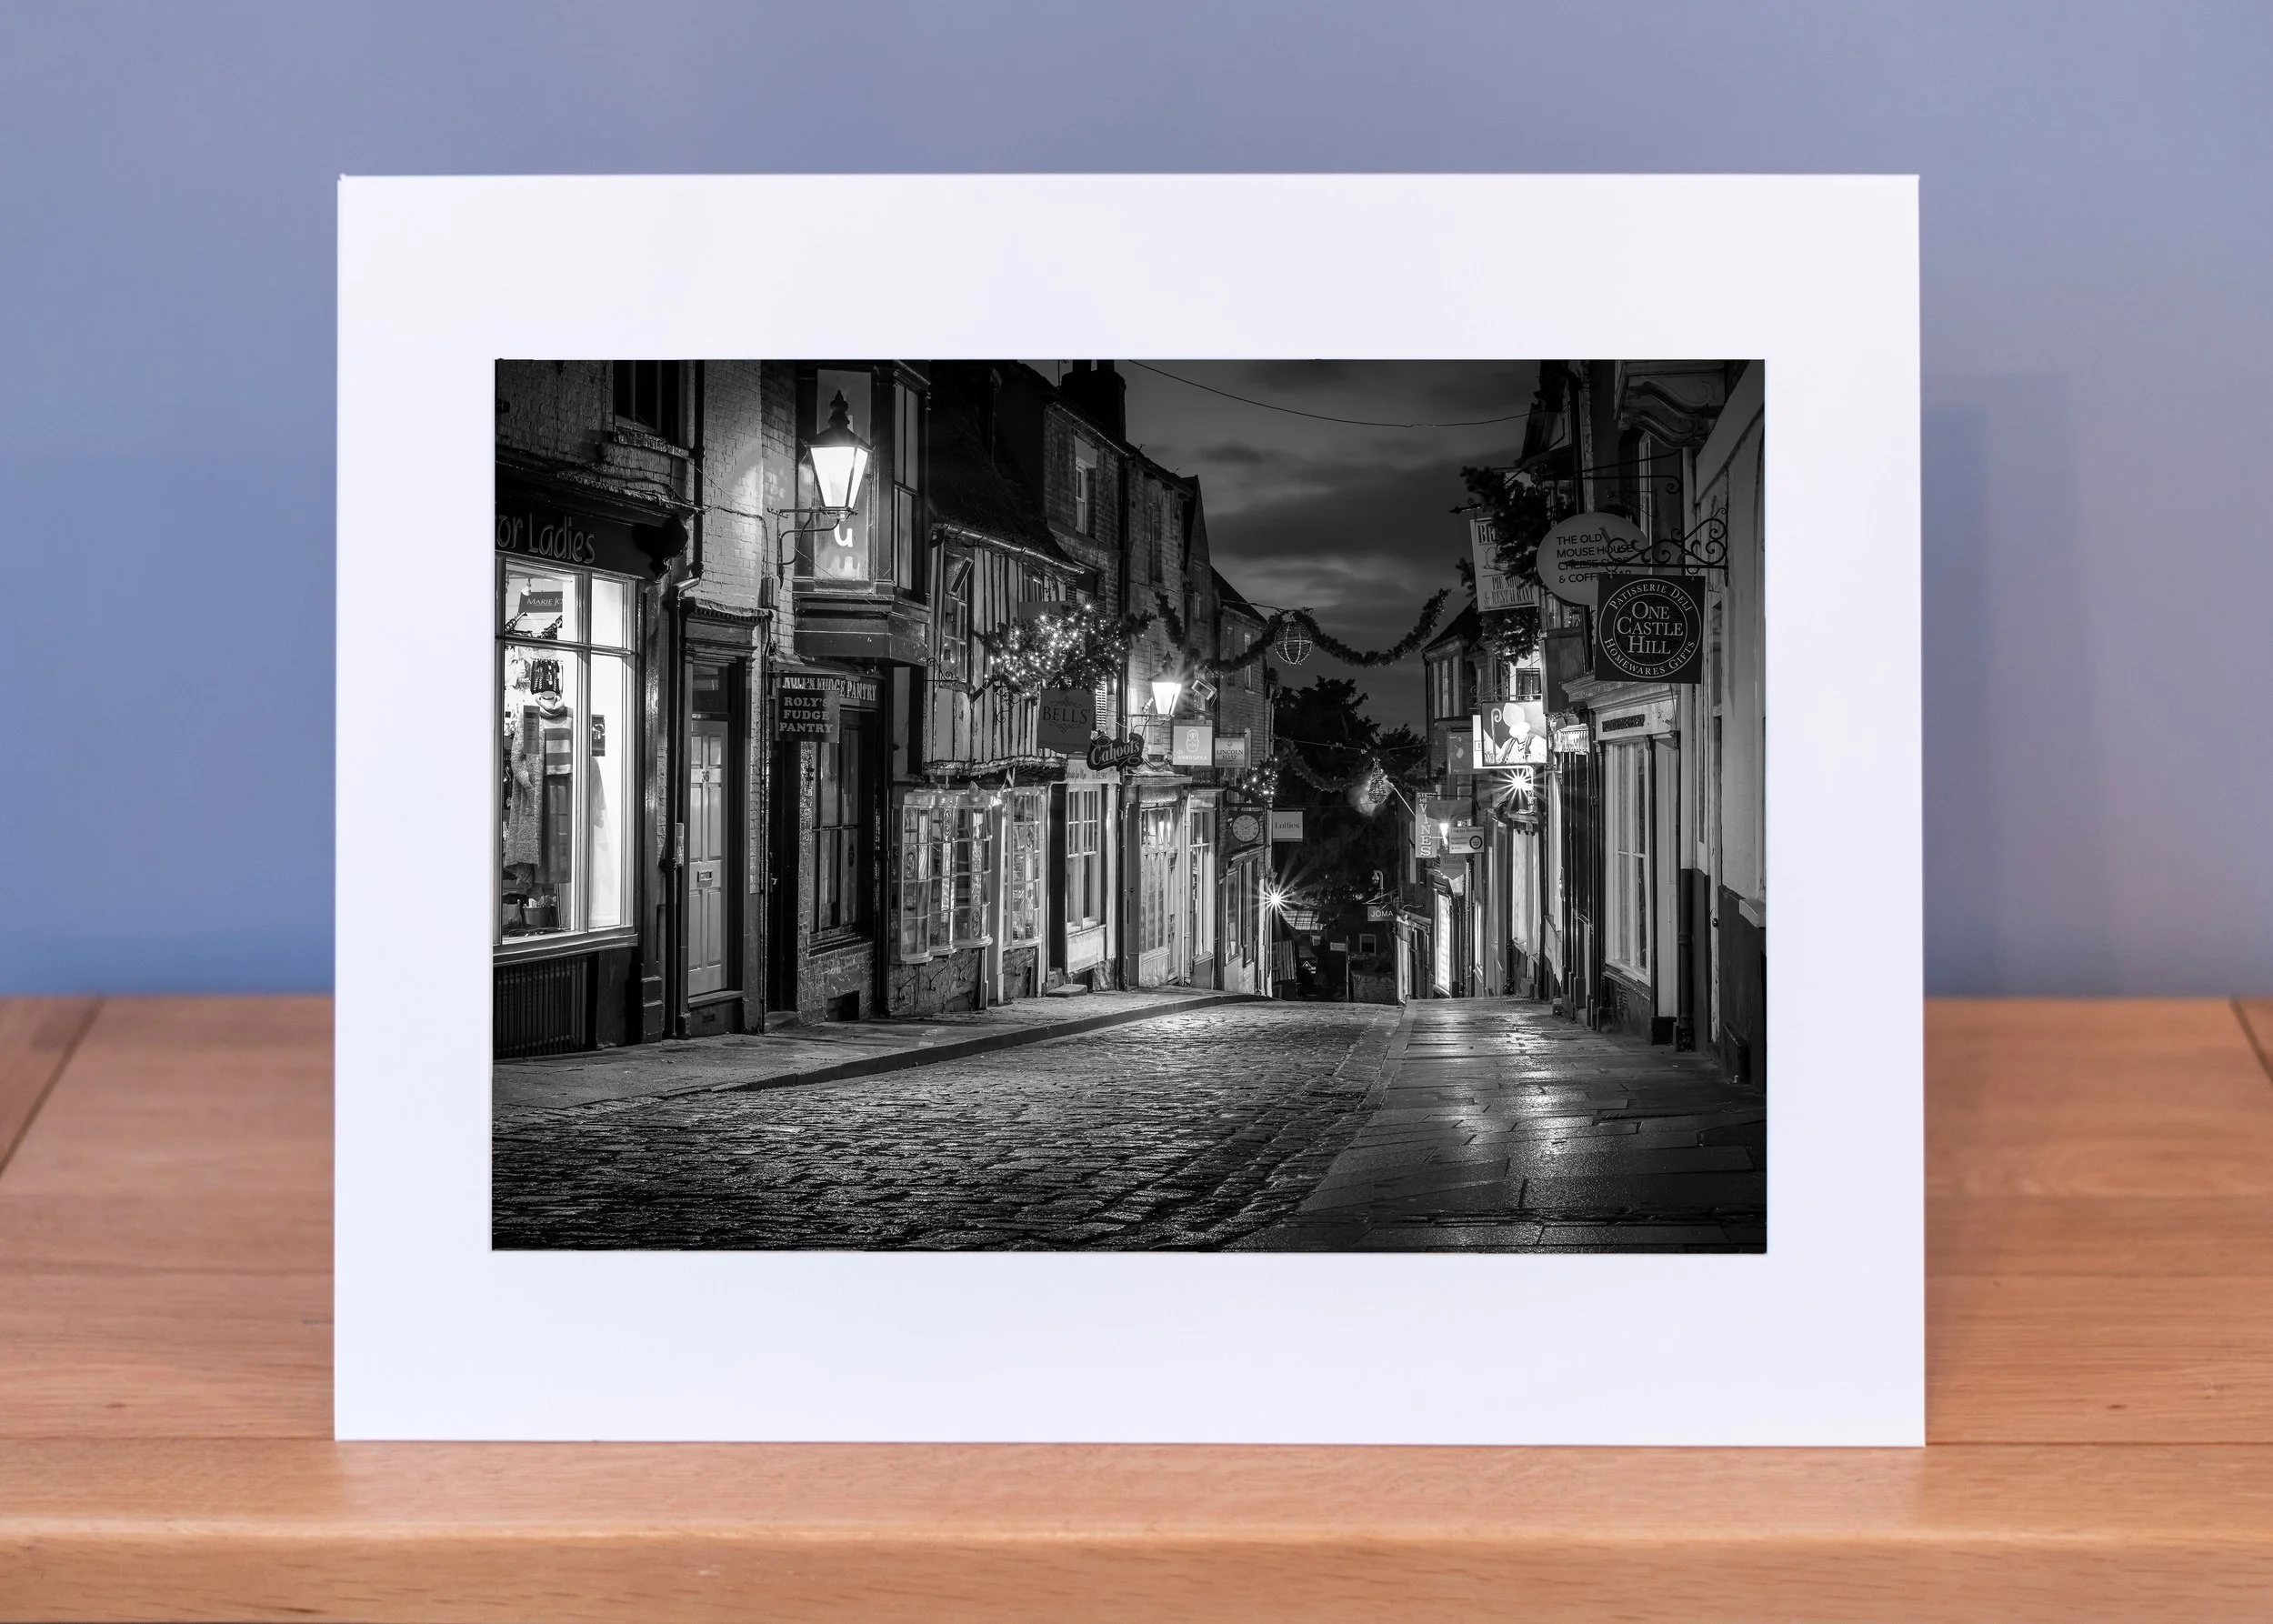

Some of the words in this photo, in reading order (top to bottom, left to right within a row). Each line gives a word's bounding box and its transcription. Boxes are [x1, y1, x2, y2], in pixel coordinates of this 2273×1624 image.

[527, 512, 596, 564] Ladies
[1557, 536, 1577, 546] THE
[1580, 533, 1602, 543] OLD
[1557, 546, 1595, 557] MOUSE
[1597, 544, 1634, 556] HOUSE
[1506, 575, 1522, 589] SHO
[1559, 576, 1566, 584] &
[1609, 584, 1667, 609] PATISSERIE
[1670, 588, 1693, 612] DELI
[1631, 601, 1670, 620] ONE
[1617, 617, 1684, 636] CASTLE
[1627, 635, 1671, 655] HILL
[1604, 637, 1666, 676] HOMEWARES
[1668, 641, 1696, 671] GIFTS
[846, 680, 876, 702] PANTRY
[784, 697, 829, 707] ROLY'S
[783, 709, 830, 720] FUDGE
[779, 722, 834, 733] PANTRY
[1090, 737, 1141, 766] Cahoots
[701, 770, 710, 783] 36
[1418, 803, 1433, 857] VINES
